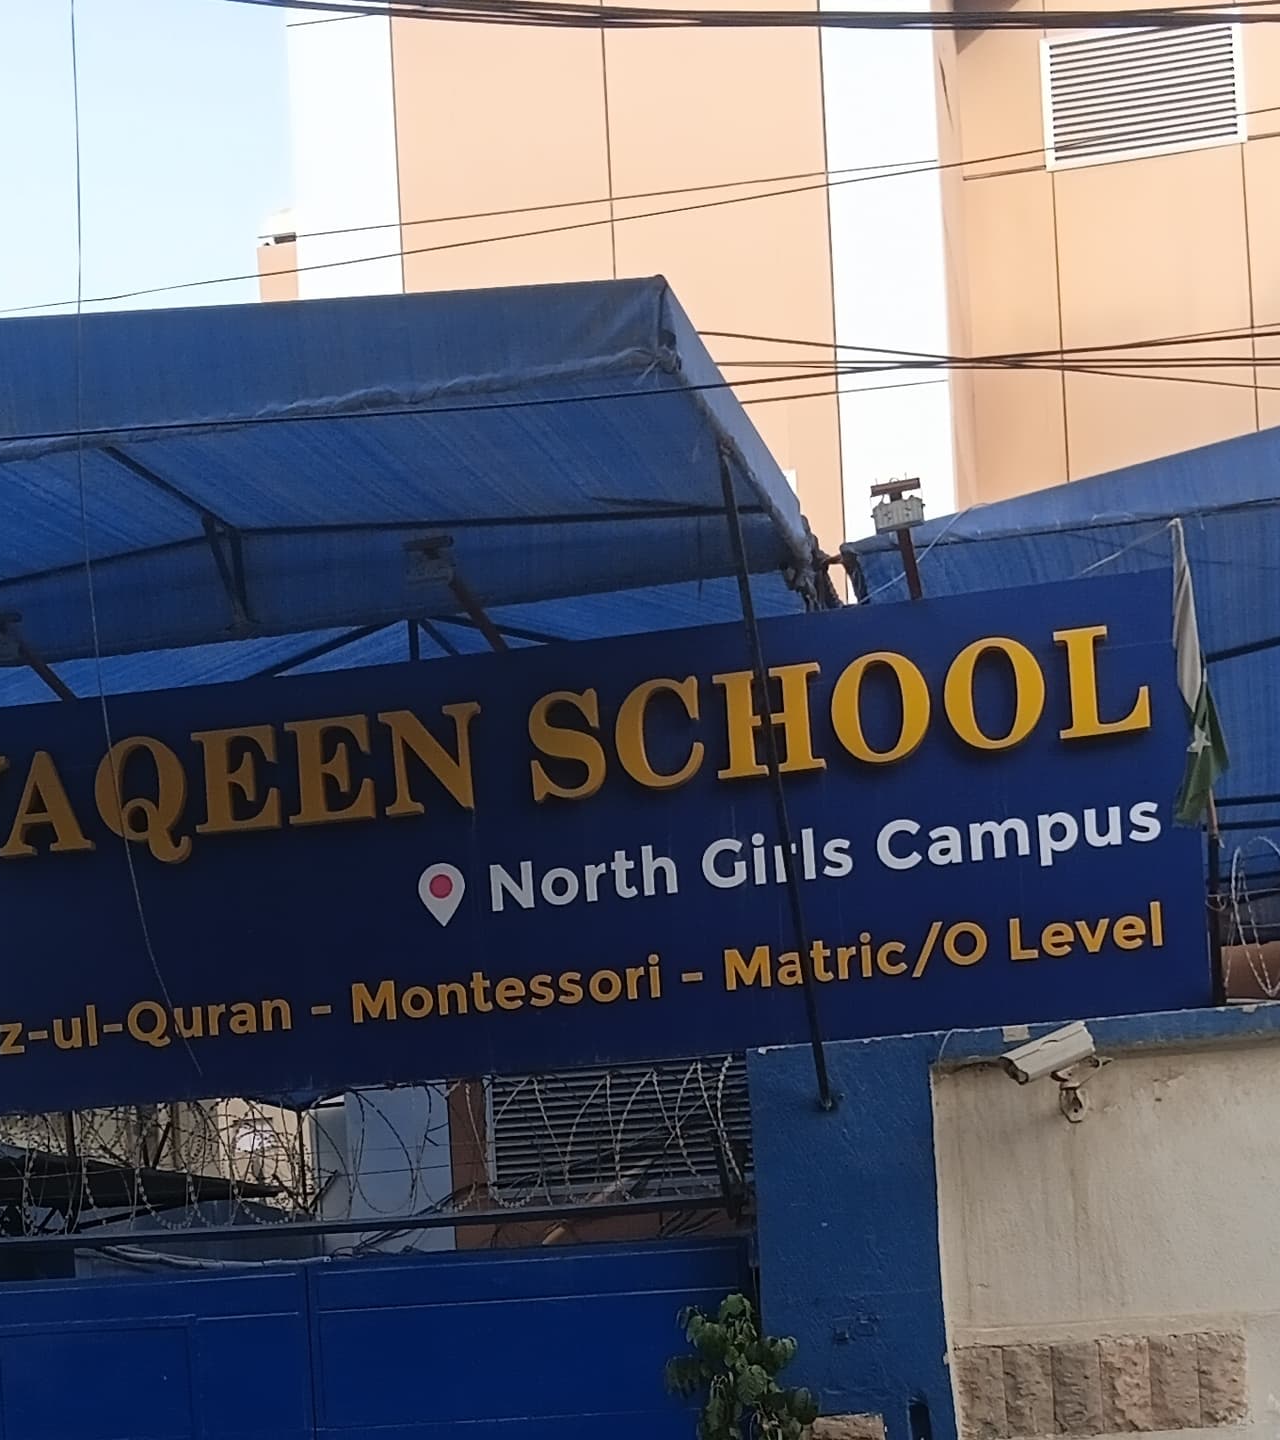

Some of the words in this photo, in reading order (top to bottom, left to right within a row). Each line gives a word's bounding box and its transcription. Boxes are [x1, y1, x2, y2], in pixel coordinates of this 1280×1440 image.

[528, 624, 1153, 802] SCHOOL
[488, 844, 679, 912] North
[876, 801, 1162, 870] Campus
[351, 954, 661, 1023] Montessori
[724, 920, 988, 991] Matric/O
[1009, 900, 1163, 961] Level
